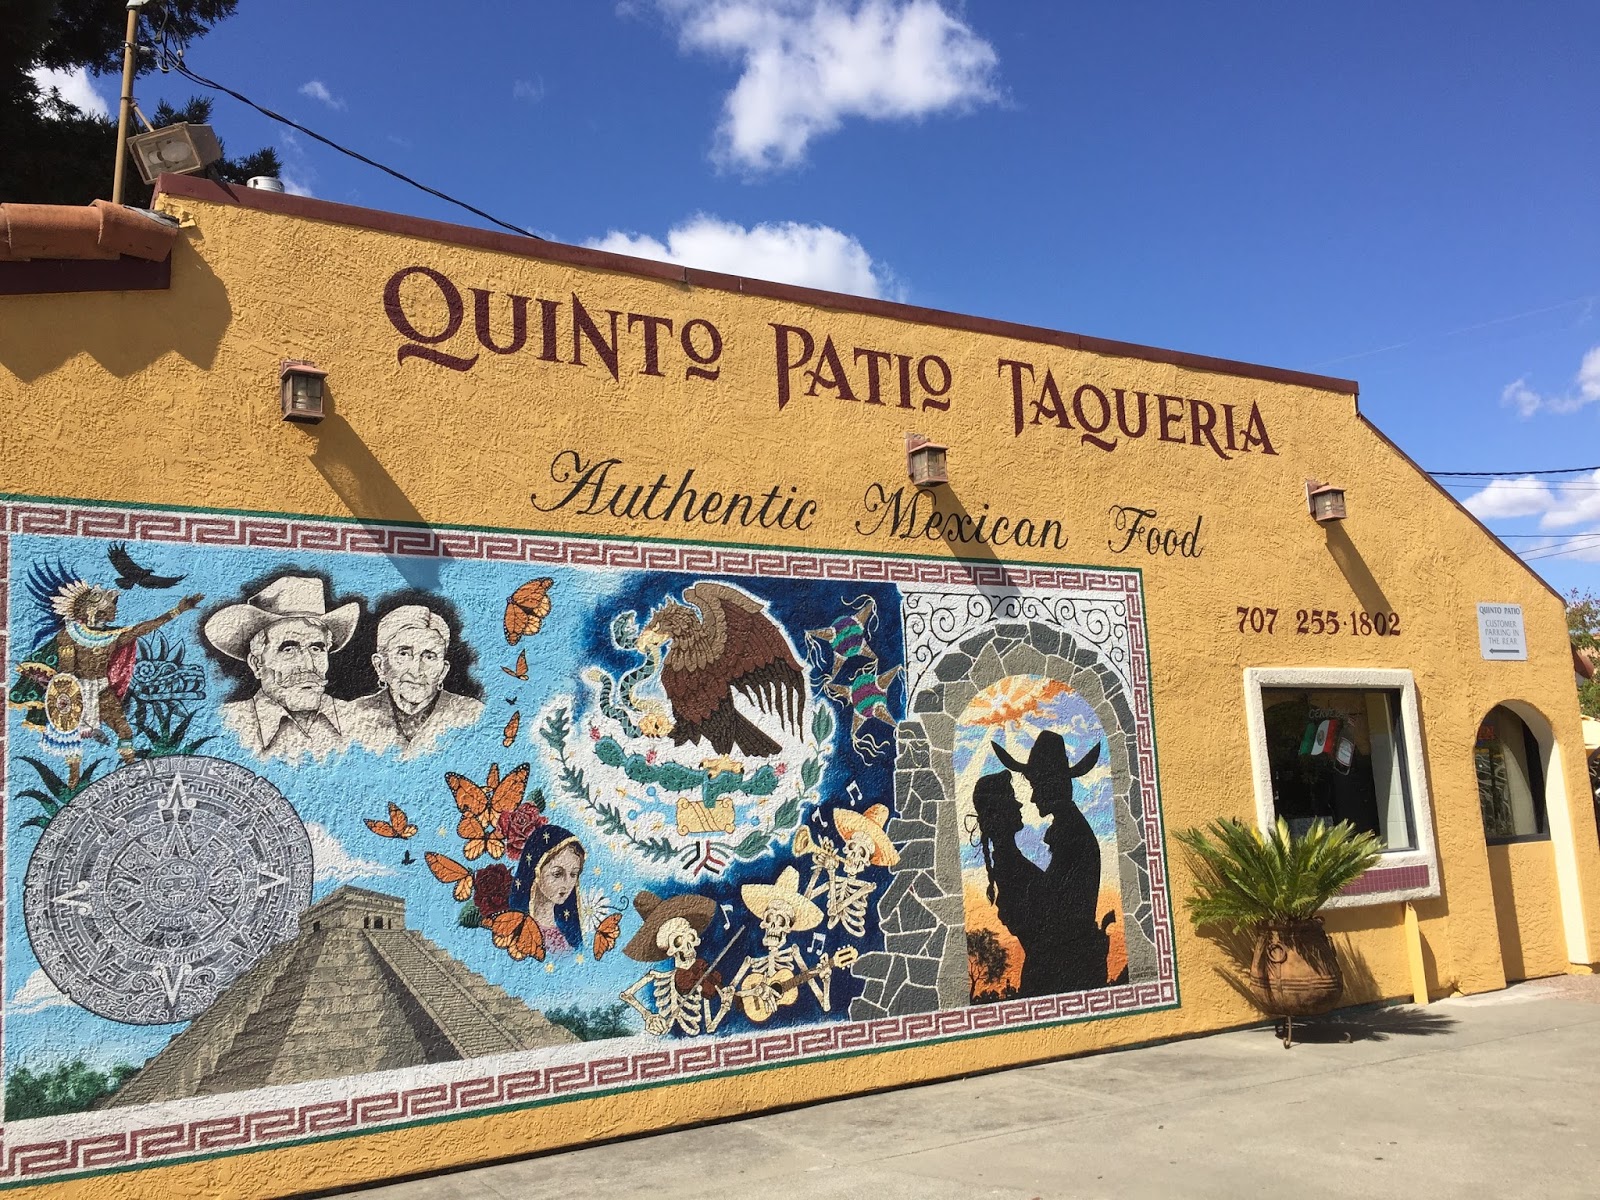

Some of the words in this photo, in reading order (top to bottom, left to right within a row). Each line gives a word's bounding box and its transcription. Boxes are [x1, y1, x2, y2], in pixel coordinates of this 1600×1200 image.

[383, 265, 724, 384] QUINTO
[767, 322, 952, 412] PATIO
[997, 358, 1280, 461] TAQUERIA
[530, 450, 817, 532] Authentic
[855, 482, 1070, 549] Mexican
[1107, 504, 1204, 559] Food
[1479, 606, 1502, 615] QUINTO
[1504, 607, 1521, 615] PATIO
[1236, 606, 1279, 635] 707
[1485, 620, 1517, 628] CUSTOMER
[1485, 628, 1511, 637] PARKING
[1513, 629, 1520, 637] IN
[1489, 637, 1499, 645] THE
[1502, 637, 1518, 645] REAR
